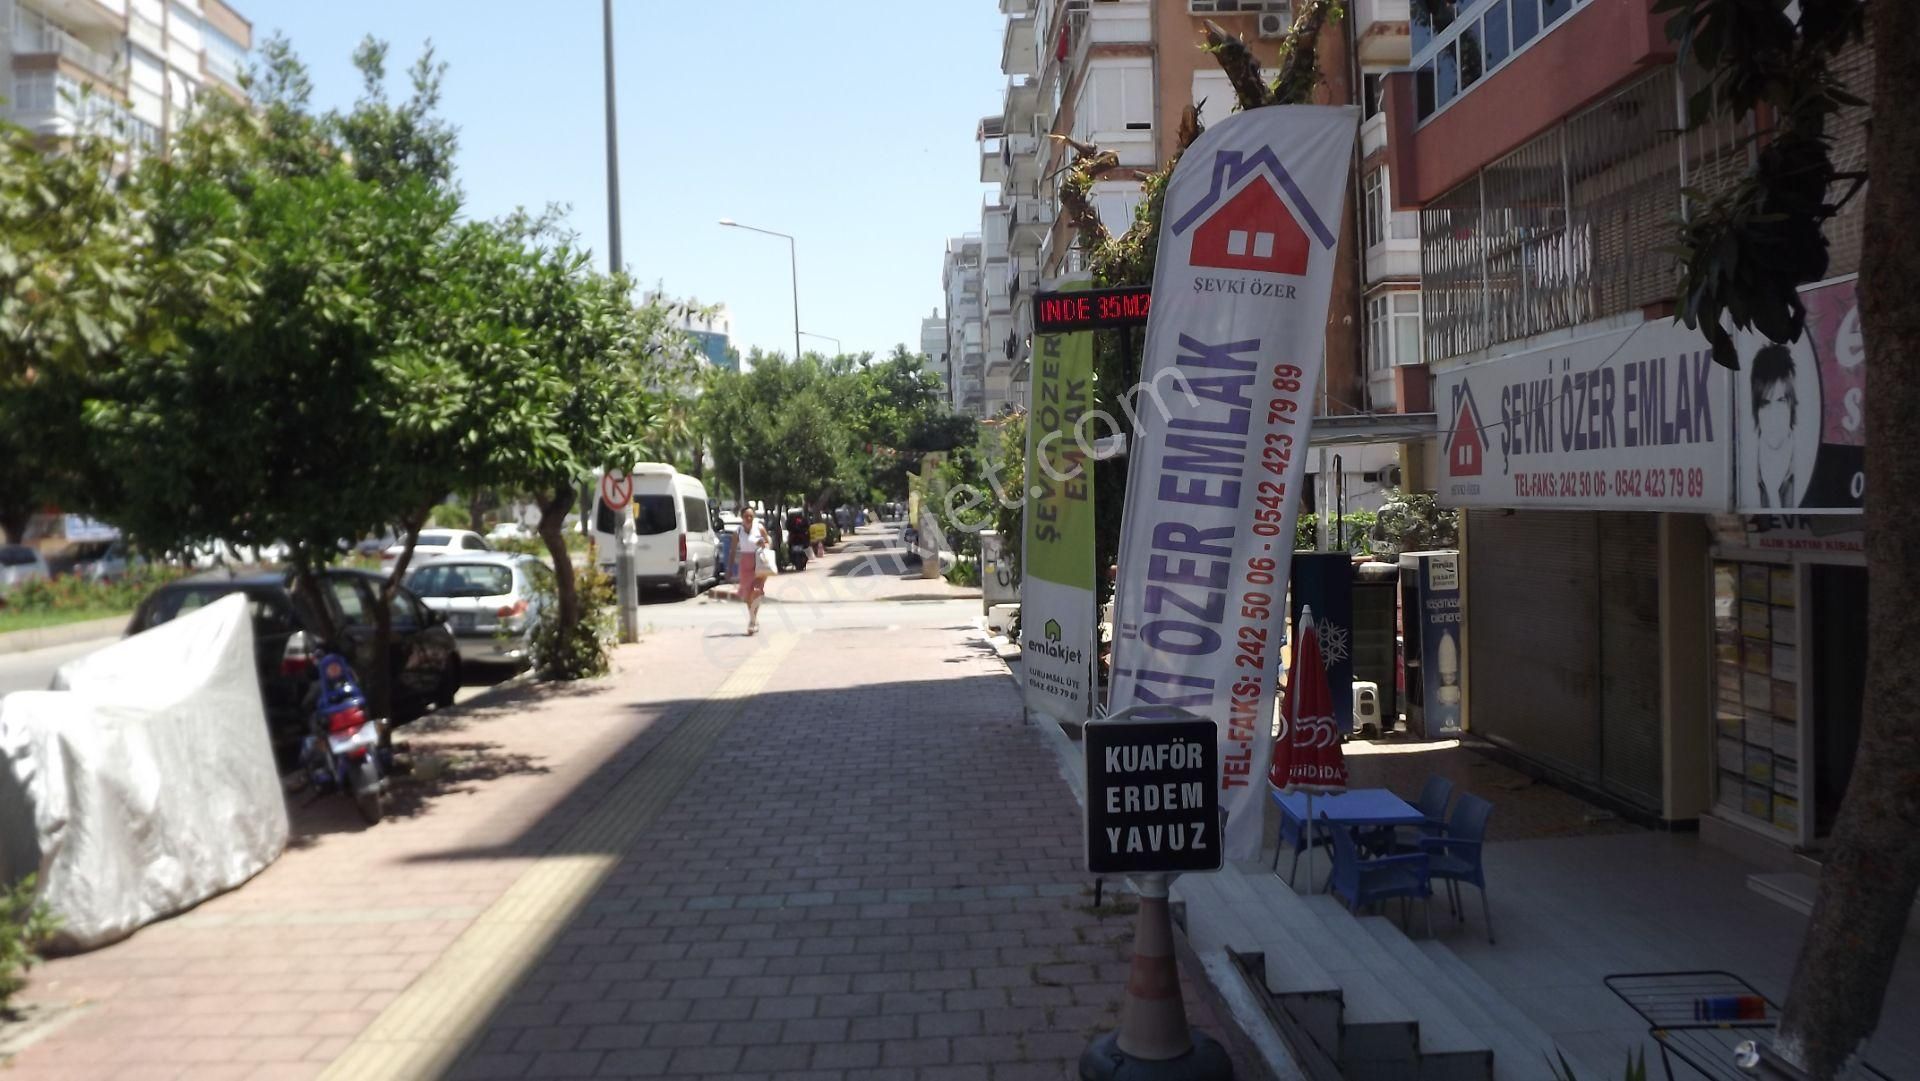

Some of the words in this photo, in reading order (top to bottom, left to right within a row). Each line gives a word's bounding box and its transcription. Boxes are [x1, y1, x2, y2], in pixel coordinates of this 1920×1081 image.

[1193, 277, 1245, 295] ŞEVKİ
[1250, 279, 1297, 300] ÖZER
[1036, 335, 1062, 433] ÖZER
[1273, 364, 1302, 393] 89
[1158, 333, 1260, 508] EMLAK
[1268, 399, 1298, 424] 79
[1500, 359, 1553, 476] ŞEVKİ
[1560, 357, 1616, 453] ÖZER
[1624, 349, 1714, 448] EMLAK
[1261, 433, 1293, 475] 423
[1514, 472, 1557, 497] TEL-FAKS:
[1559, 472, 1577, 497] 242
[1580, 471, 1591, 497] 50
[1593, 470, 1606, 497] 06
[1615, 469, 1642, 497] 0542
[1645, 468, 1666, 498] 423
[1669, 467, 1684, 498] 79
[1687, 467, 1704, 498] 89
[1253, 481, 1286, 536] 0542
[1247, 557, 1276, 584] 06
[1122, 522, 1236, 655] ÖZER
[1241, 593, 1272, 620] 50
[1235, 626, 1267, 670] 242
[1105, 738, 1203, 773] KUAFÖR
[1107, 782, 1203, 814] ERDEM
[1106, 822, 1207, 854] YAVUZ
